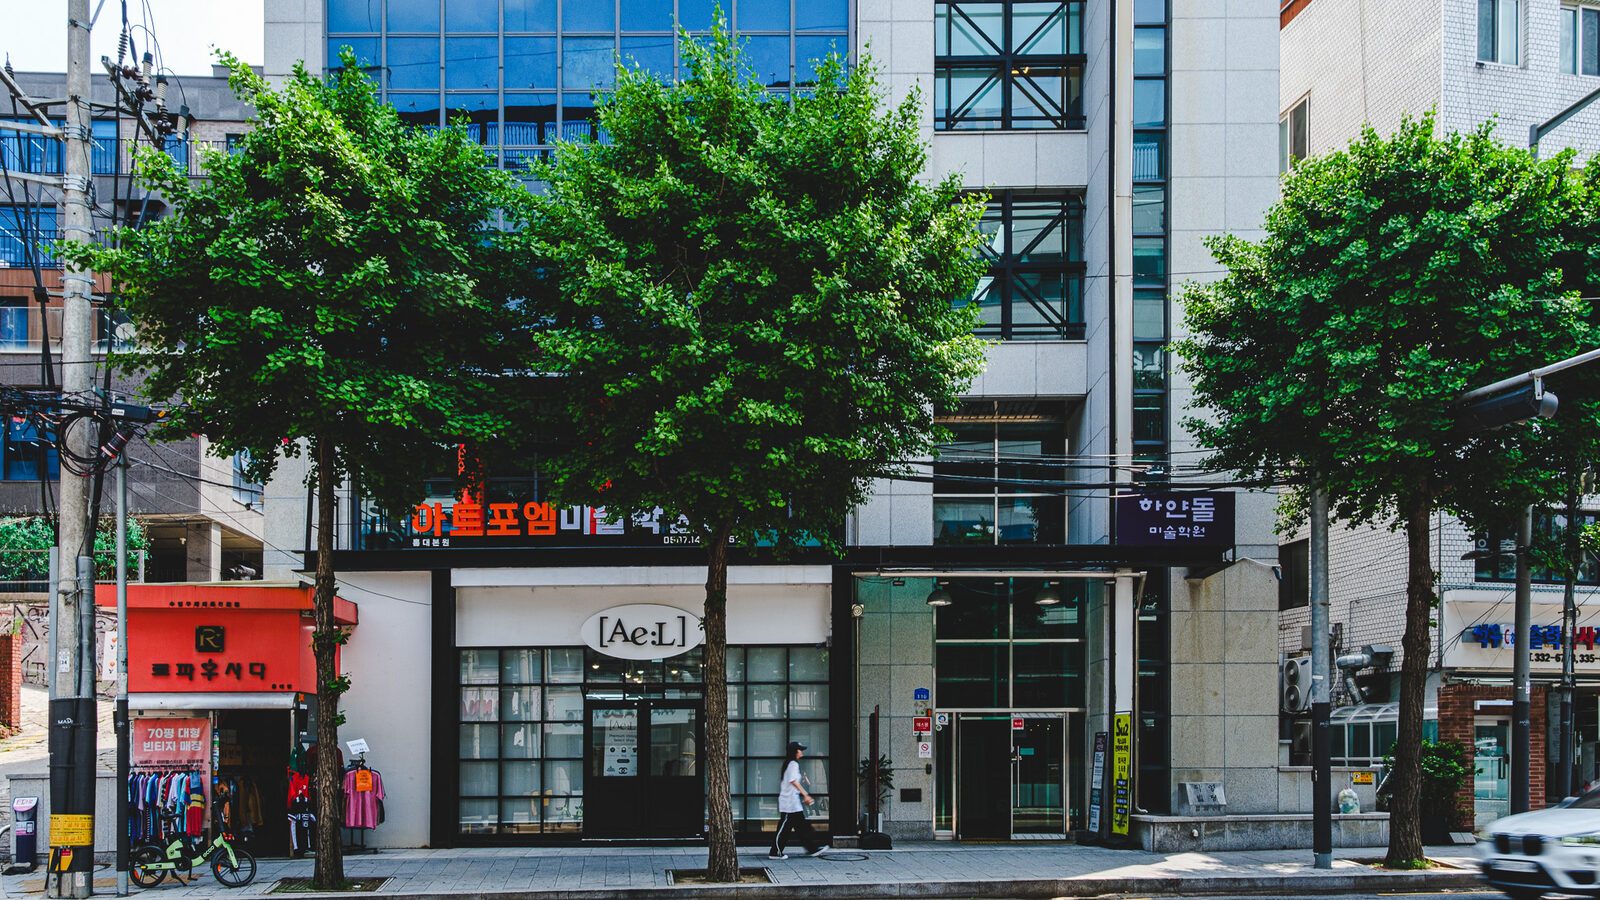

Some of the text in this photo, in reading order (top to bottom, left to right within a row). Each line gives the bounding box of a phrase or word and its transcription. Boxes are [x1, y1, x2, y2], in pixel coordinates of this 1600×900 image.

[1139, 498, 1215, 522] 하얀돌
[1149, 525, 1205, 540] 미술학원
[599, 615, 686, 648] [Ae:L]
[147, 728, 200, 739] 70평 대형
[143, 741, 202, 752] 빈티지 매장
